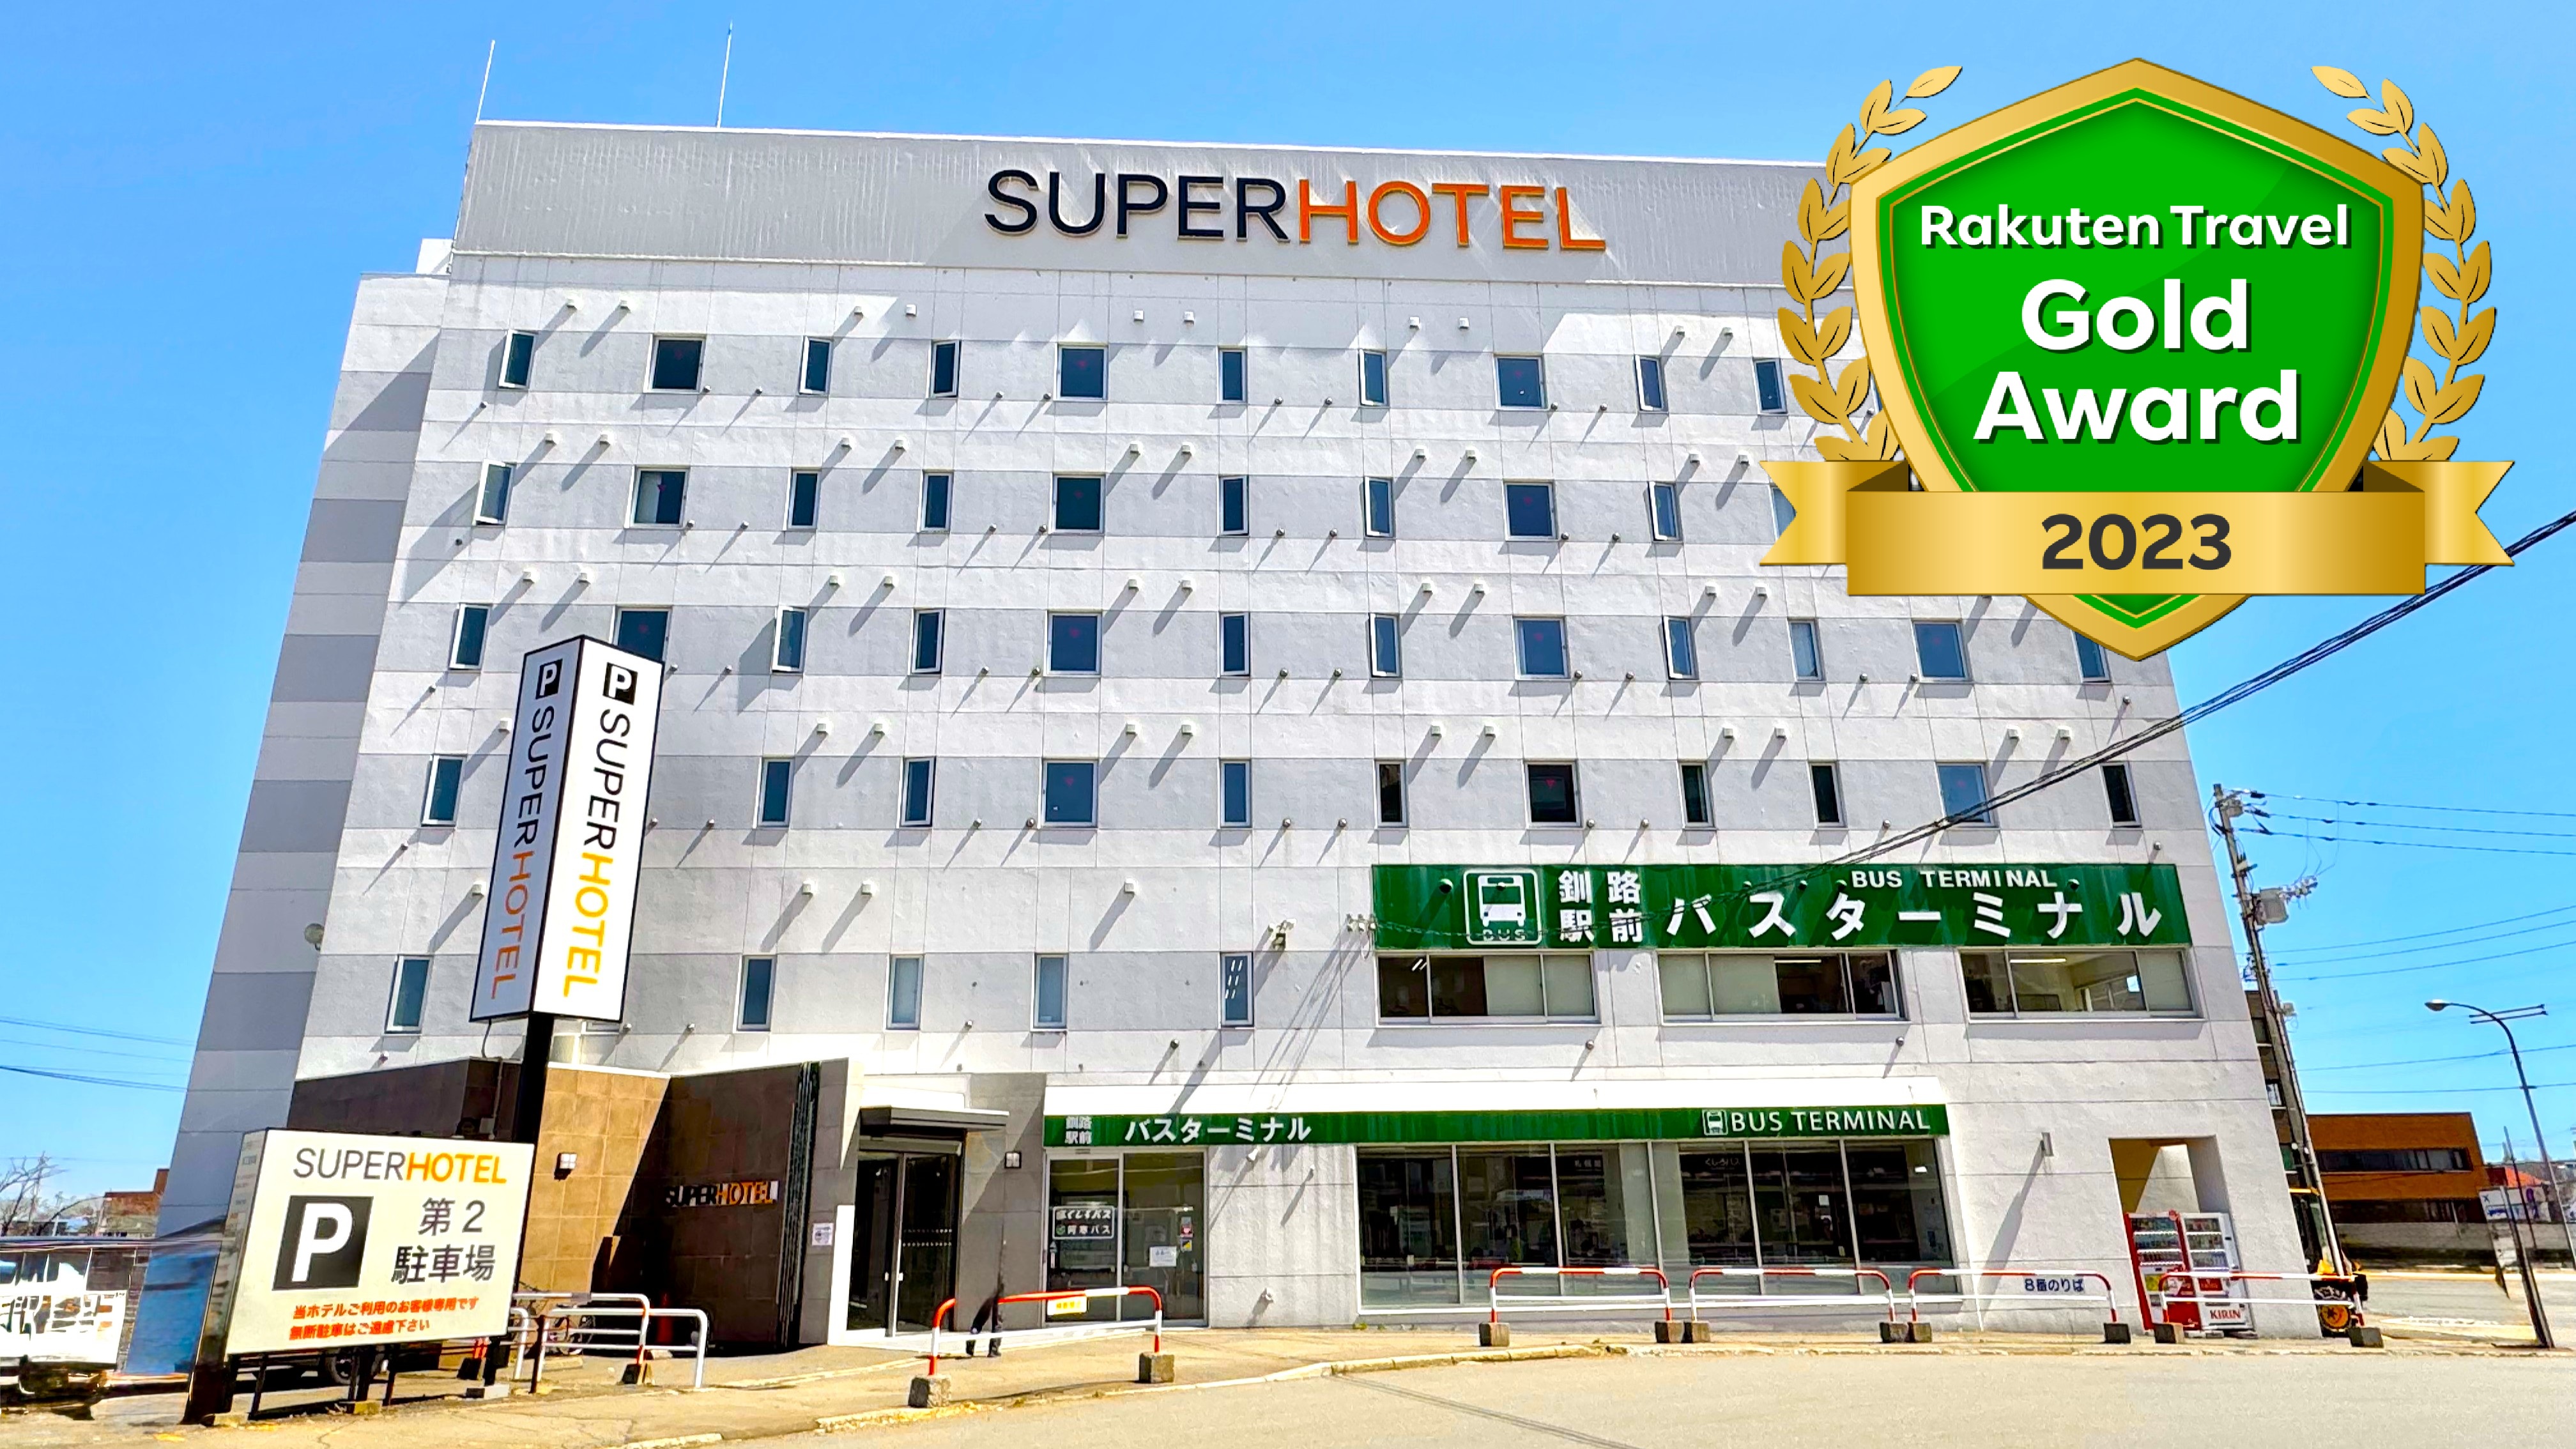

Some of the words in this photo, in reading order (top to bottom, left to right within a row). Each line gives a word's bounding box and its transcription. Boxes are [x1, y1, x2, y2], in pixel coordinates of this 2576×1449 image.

[984, 169, 1606, 250] SUPERHOTEL
[491, 706, 555, 999] SUPERHOTEL
[563, 709, 631, 998] SUPERHOTEL
[1558, 870, 1641, 905] 釧路
[1852, 870, 1903, 888] BUS
[1920, 870, 2058, 889] TERMINAL
[1560, 908, 1643, 944] 駅前
[1666, 892, 2162, 941] バスターミナル
[1482, 929, 1526, 941] BUS
[1124, 1117, 1312, 1144] バスターミナル
[1731, 1112, 1782, 1132] BUS
[1791, 1110, 1931, 1131] TERMINAL
[293, 1147, 507, 1184] SUPERHOTEL
[291, 1202, 353, 1282] P
[390, 1244, 496, 1285] 駐車場
[2209, 1309, 2241, 1319] KIRIN
